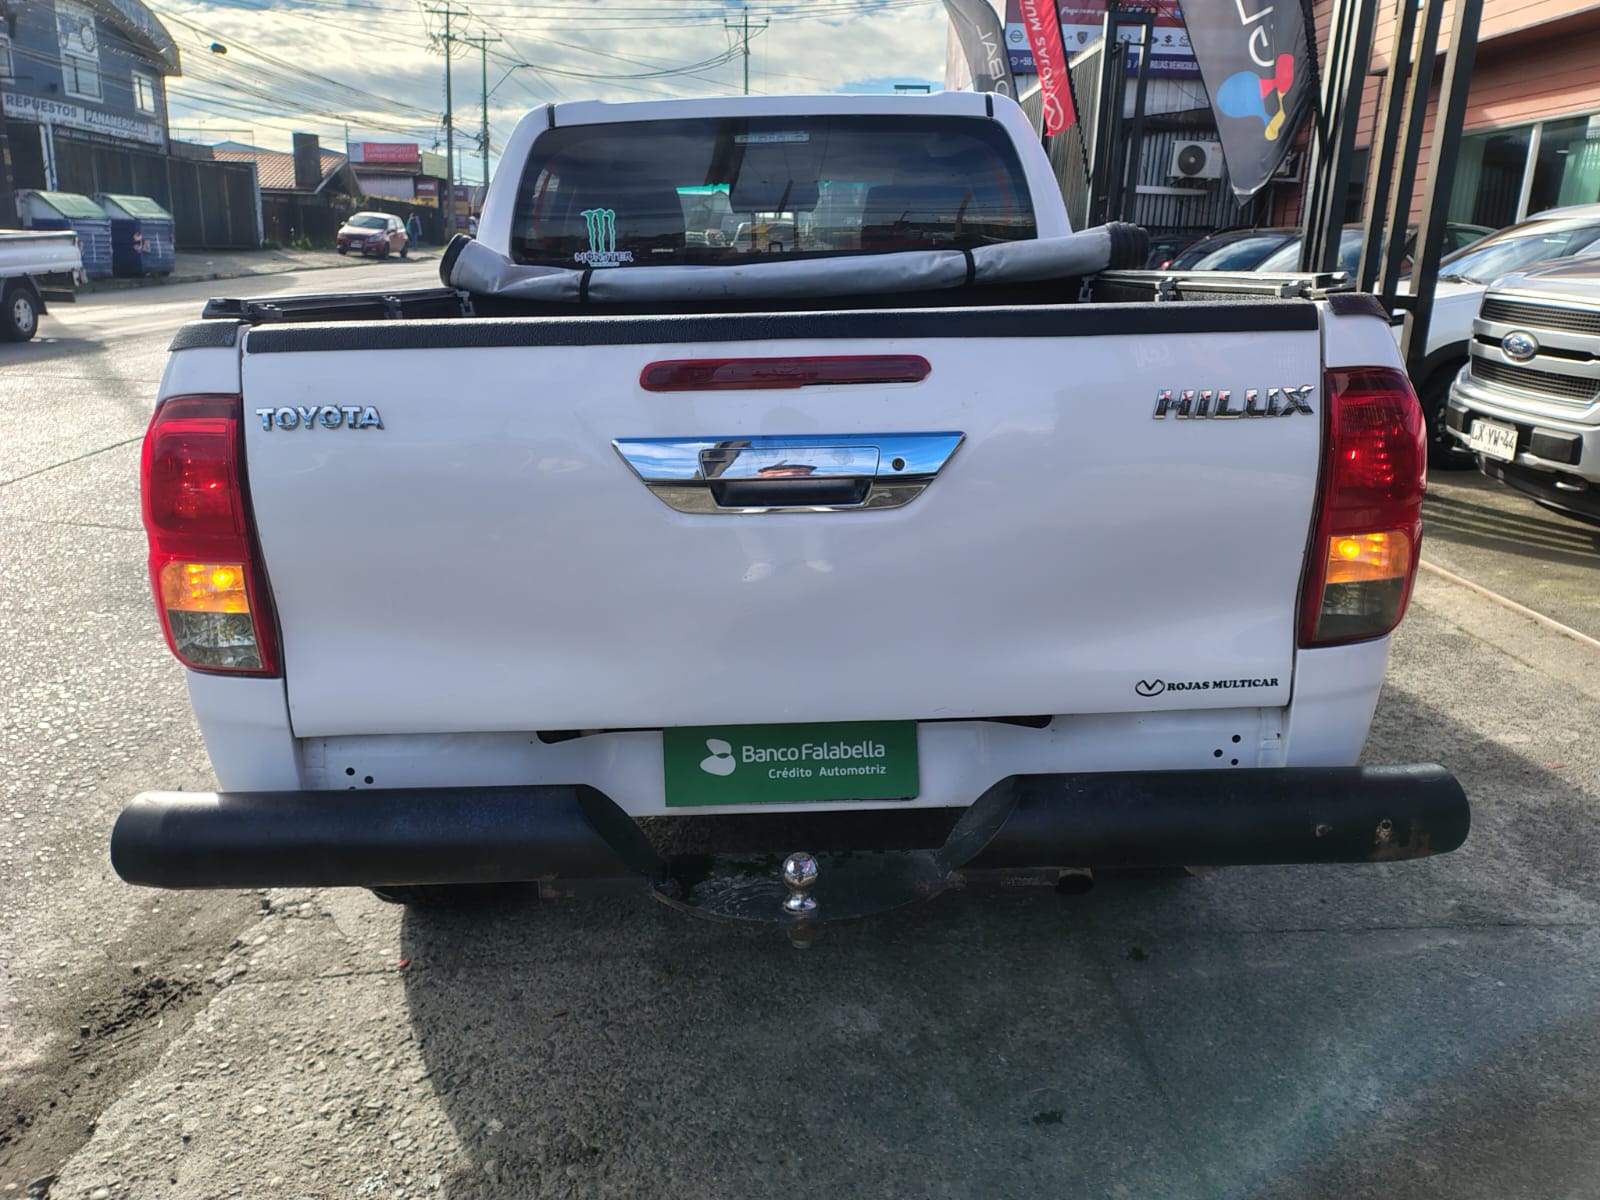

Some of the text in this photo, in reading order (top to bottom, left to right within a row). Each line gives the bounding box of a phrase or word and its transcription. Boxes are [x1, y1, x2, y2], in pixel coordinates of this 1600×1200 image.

[1034, 36, 1055, 91] ROJAS
[5, 94, 77, 118] REPUESTOS
[574, 249, 634, 264] MONSTER
[1152, 383, 1315, 419] HILUX
[255, 405, 385, 432] TOYOTA
[1167, 678, 1279, 692] ROJAS MULTICAR
[768, 764, 887, 779] Crédito Automotriz
